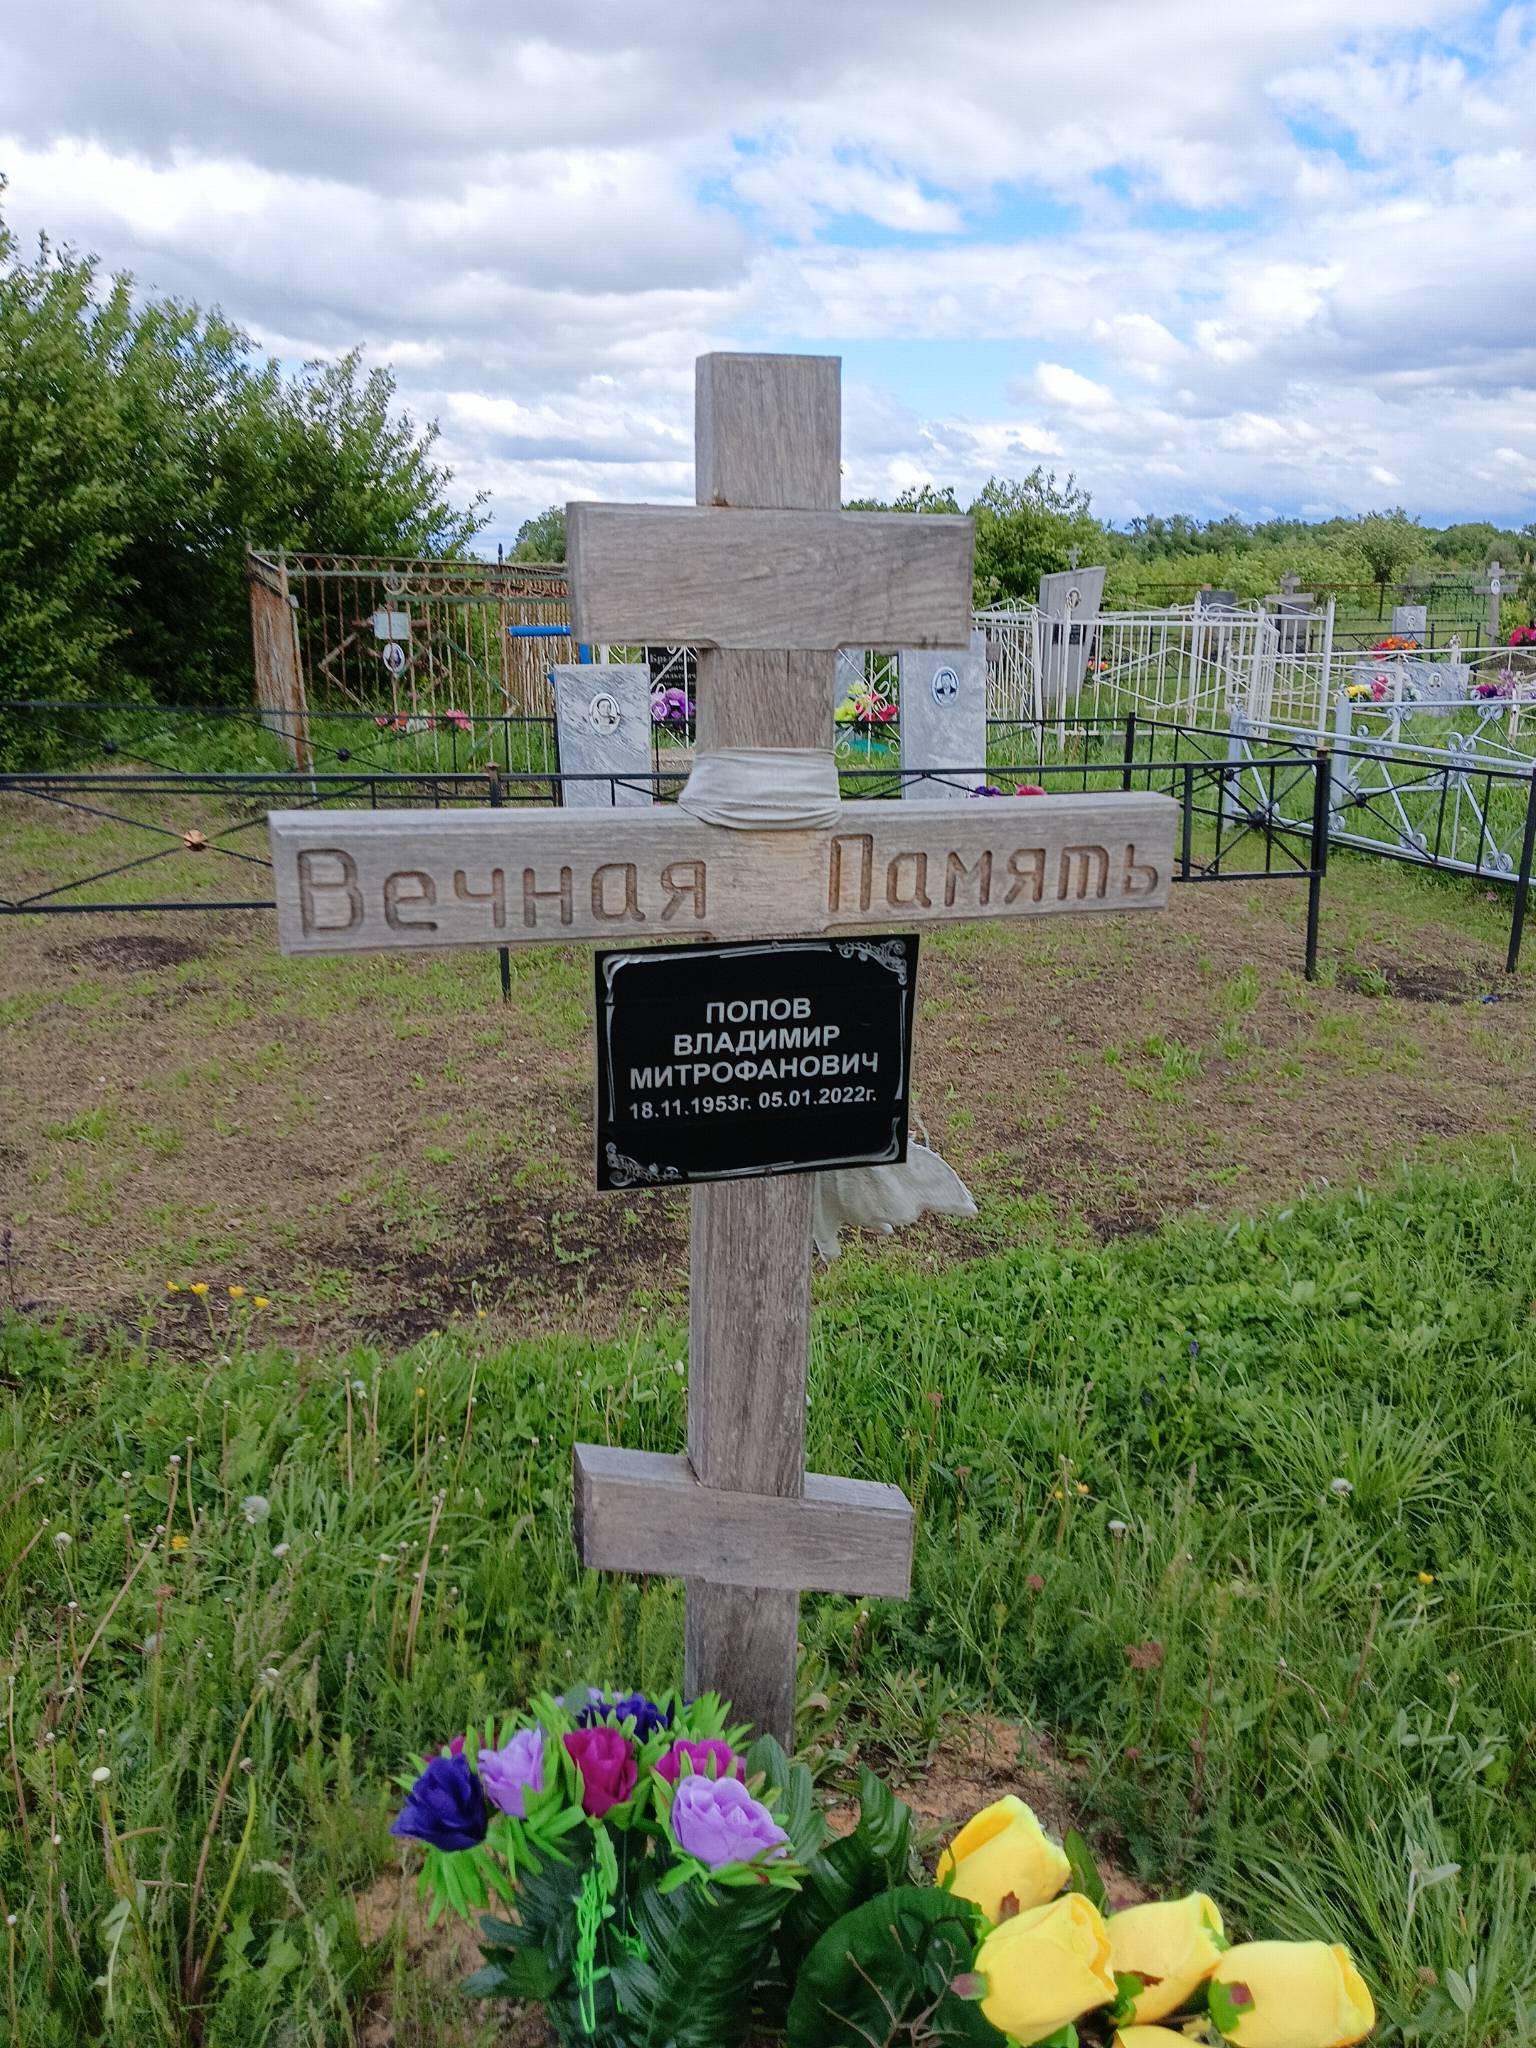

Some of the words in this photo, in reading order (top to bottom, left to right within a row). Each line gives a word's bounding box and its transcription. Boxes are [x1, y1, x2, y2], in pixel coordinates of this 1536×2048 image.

[298, 848, 707, 938] Вечная
[827, 833, 1159, 913] Память
[705, 997, 812, 1024] ПОПОВ
[673, 1025, 840, 1056] ВЛАДИМИР
[630, 1052, 878, 1090] МИТРОФАНОВИЧ
[629, 1094, 752, 1119] 18.11.1953г.
[758, 1086, 877, 1109] 05.01.2022г.
